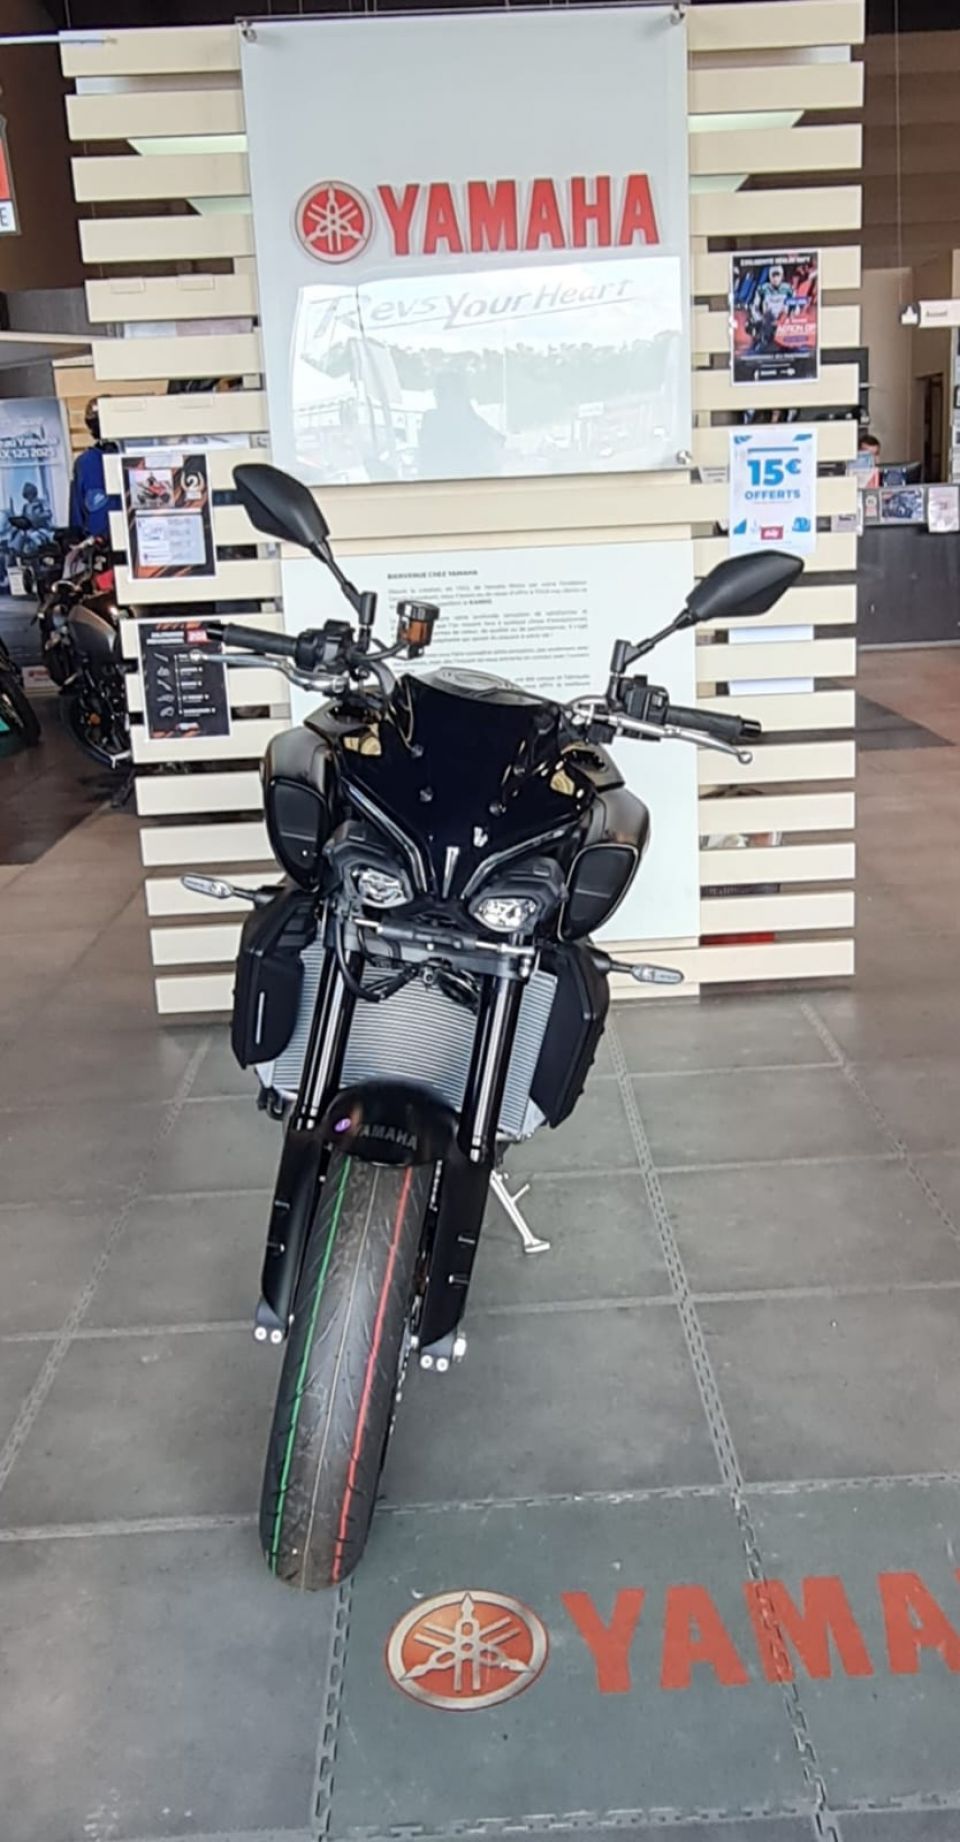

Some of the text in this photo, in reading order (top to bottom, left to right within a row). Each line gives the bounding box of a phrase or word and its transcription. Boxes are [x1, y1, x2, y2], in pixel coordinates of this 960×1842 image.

[377, 173, 661, 257] YAMAHA
[309, 277, 636, 340] Revs Your Heart
[745, 489, 801, 500] OFFERTS
[747, 458, 802, 487] 15€
[354, 1123, 419, 1151] YAMAHA
[560, 1568, 960, 1694] YAMA
